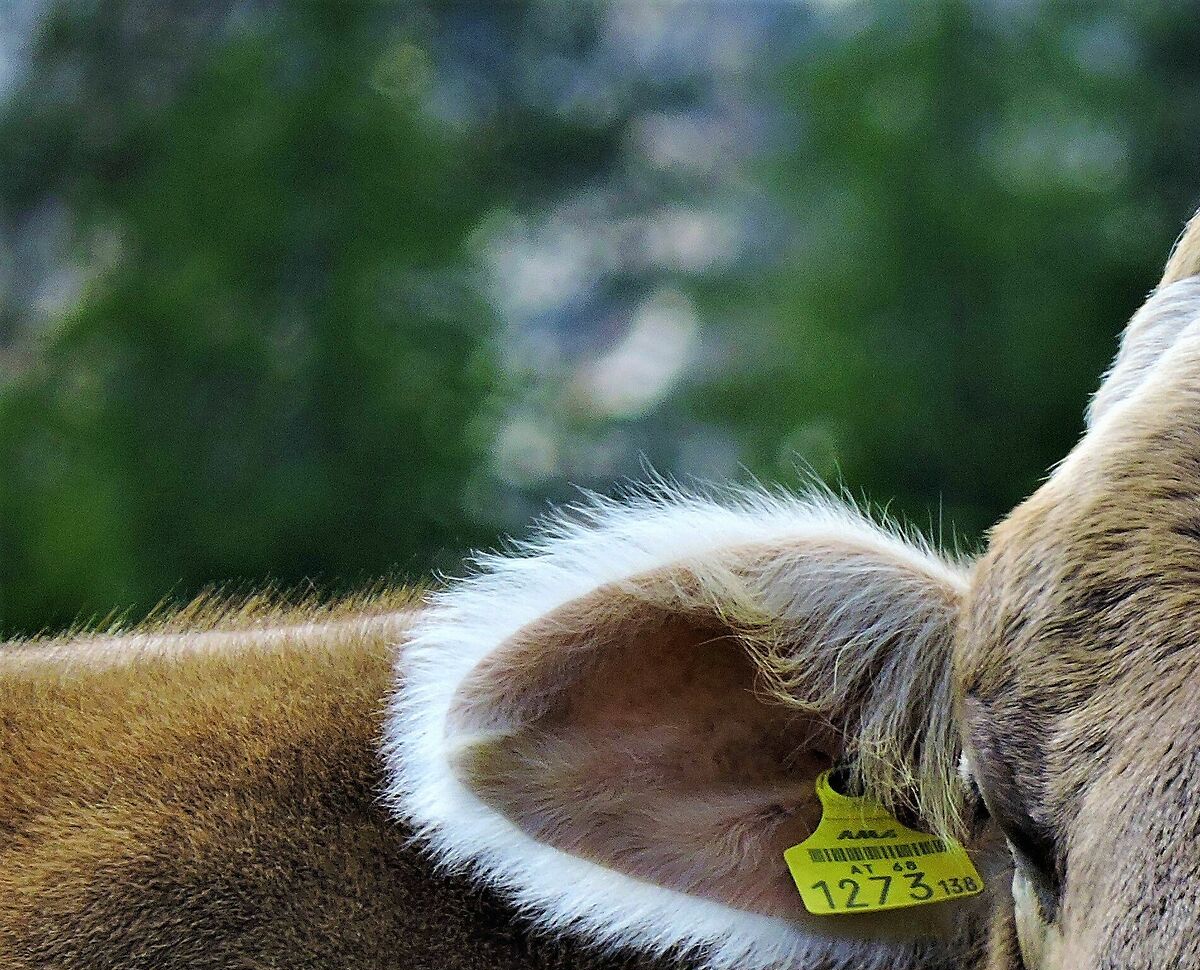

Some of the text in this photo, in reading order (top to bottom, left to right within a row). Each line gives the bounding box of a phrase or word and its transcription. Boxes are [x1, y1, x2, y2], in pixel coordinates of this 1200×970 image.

[851, 861, 917, 875] AT 68
[811, 872, 978, 909] 1273 138
